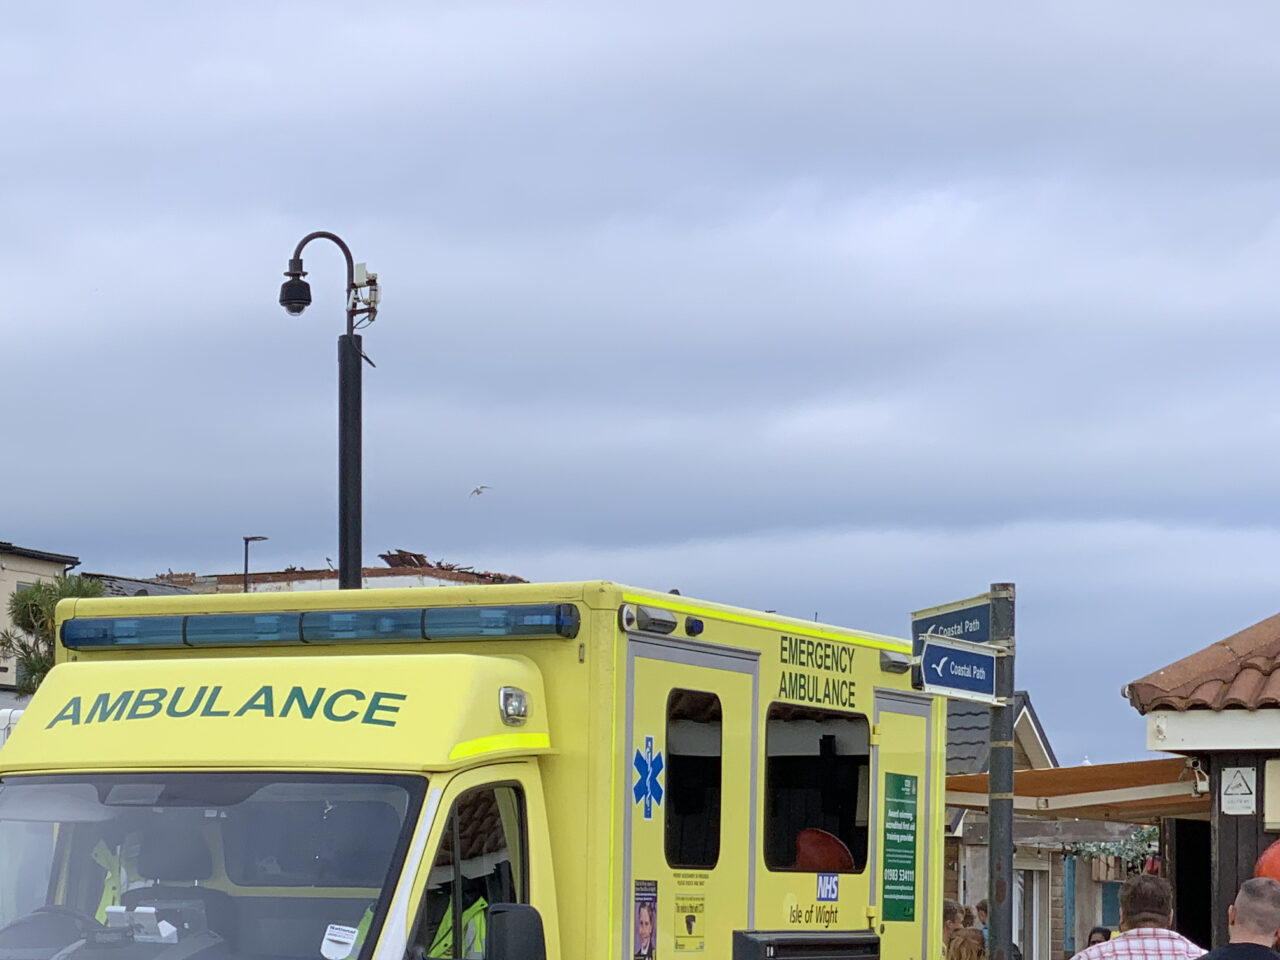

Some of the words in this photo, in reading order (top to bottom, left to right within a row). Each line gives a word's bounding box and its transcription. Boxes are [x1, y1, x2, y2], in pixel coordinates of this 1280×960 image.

[938, 622, 963, 636] Coastal
[964, 618, 980, 632] Path
[780, 635, 855, 674] EMERGENCY
[950, 661, 972, 677] Coastal
[972, 666, 986, 680] Path
[779, 671, 855, 708] AMBULANCE
[44, 685, 408, 730] AMBULANCE
[817, 876, 838, 899] NHS
[789, 904, 803, 923] Isle
[805, 904, 814, 923] of
[815, 904, 838, 928] Wight
